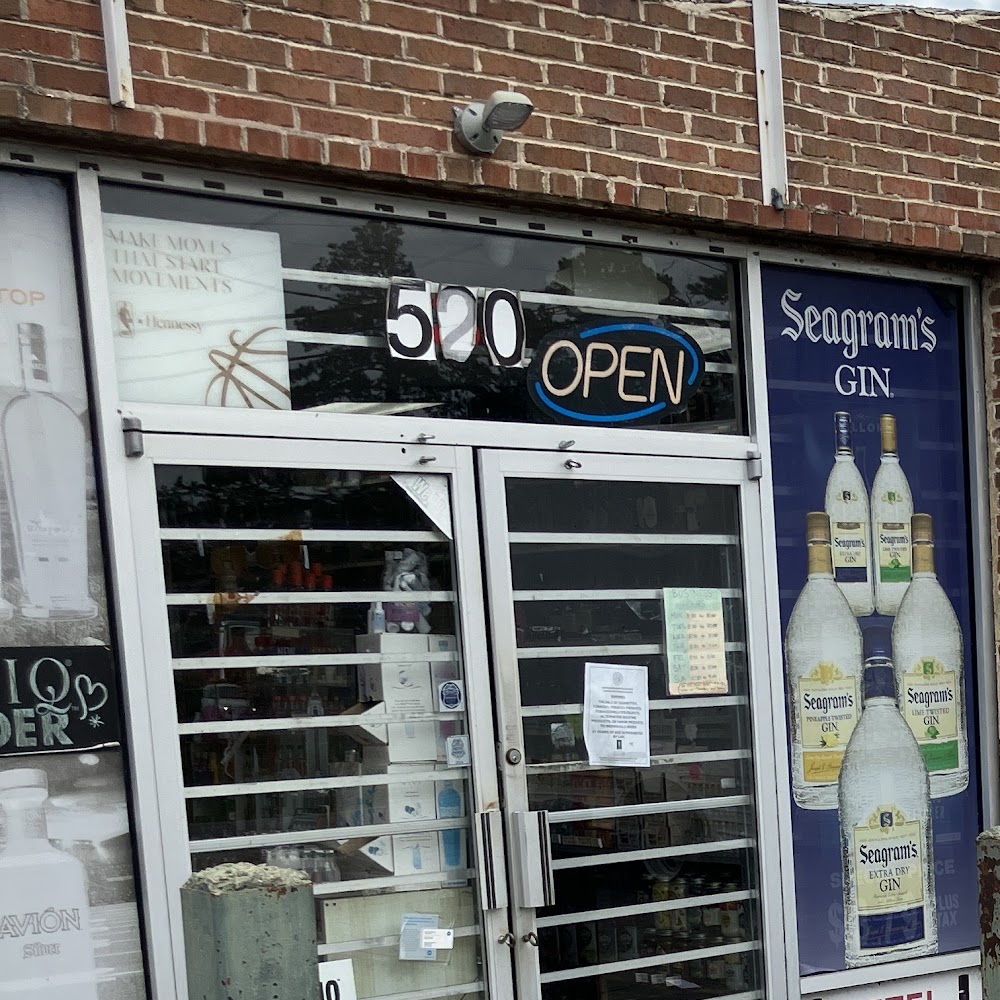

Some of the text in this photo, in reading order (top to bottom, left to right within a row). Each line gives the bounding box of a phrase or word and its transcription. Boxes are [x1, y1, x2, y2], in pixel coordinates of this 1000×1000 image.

[104, 228, 232, 254] MAKE MOVES
[113, 248, 220, 274] THAT START
[112, 267, 233, 293] MOVEMENTS
[144, 314, 202, 334] Hennessy
[387, 282, 526, 366] 520
[780, 288, 937, 359] Seagram's
[541, 339, 685, 405] OPEN
[834, 364, 891, 398] GIN
[834, 537, 865, 550] Seagram's
[803, 692, 854, 715] Seagram's
[907, 686, 954, 708] Seagram's
[821, 721, 840, 733] GIN
[923, 715, 940, 726] GIN
[859, 840, 918, 869] Seagram's
[869, 866, 910, 880] EXTRA DRY
[879, 877, 901, 893] GIN
[0, 907, 82, 940] AVIÓN
